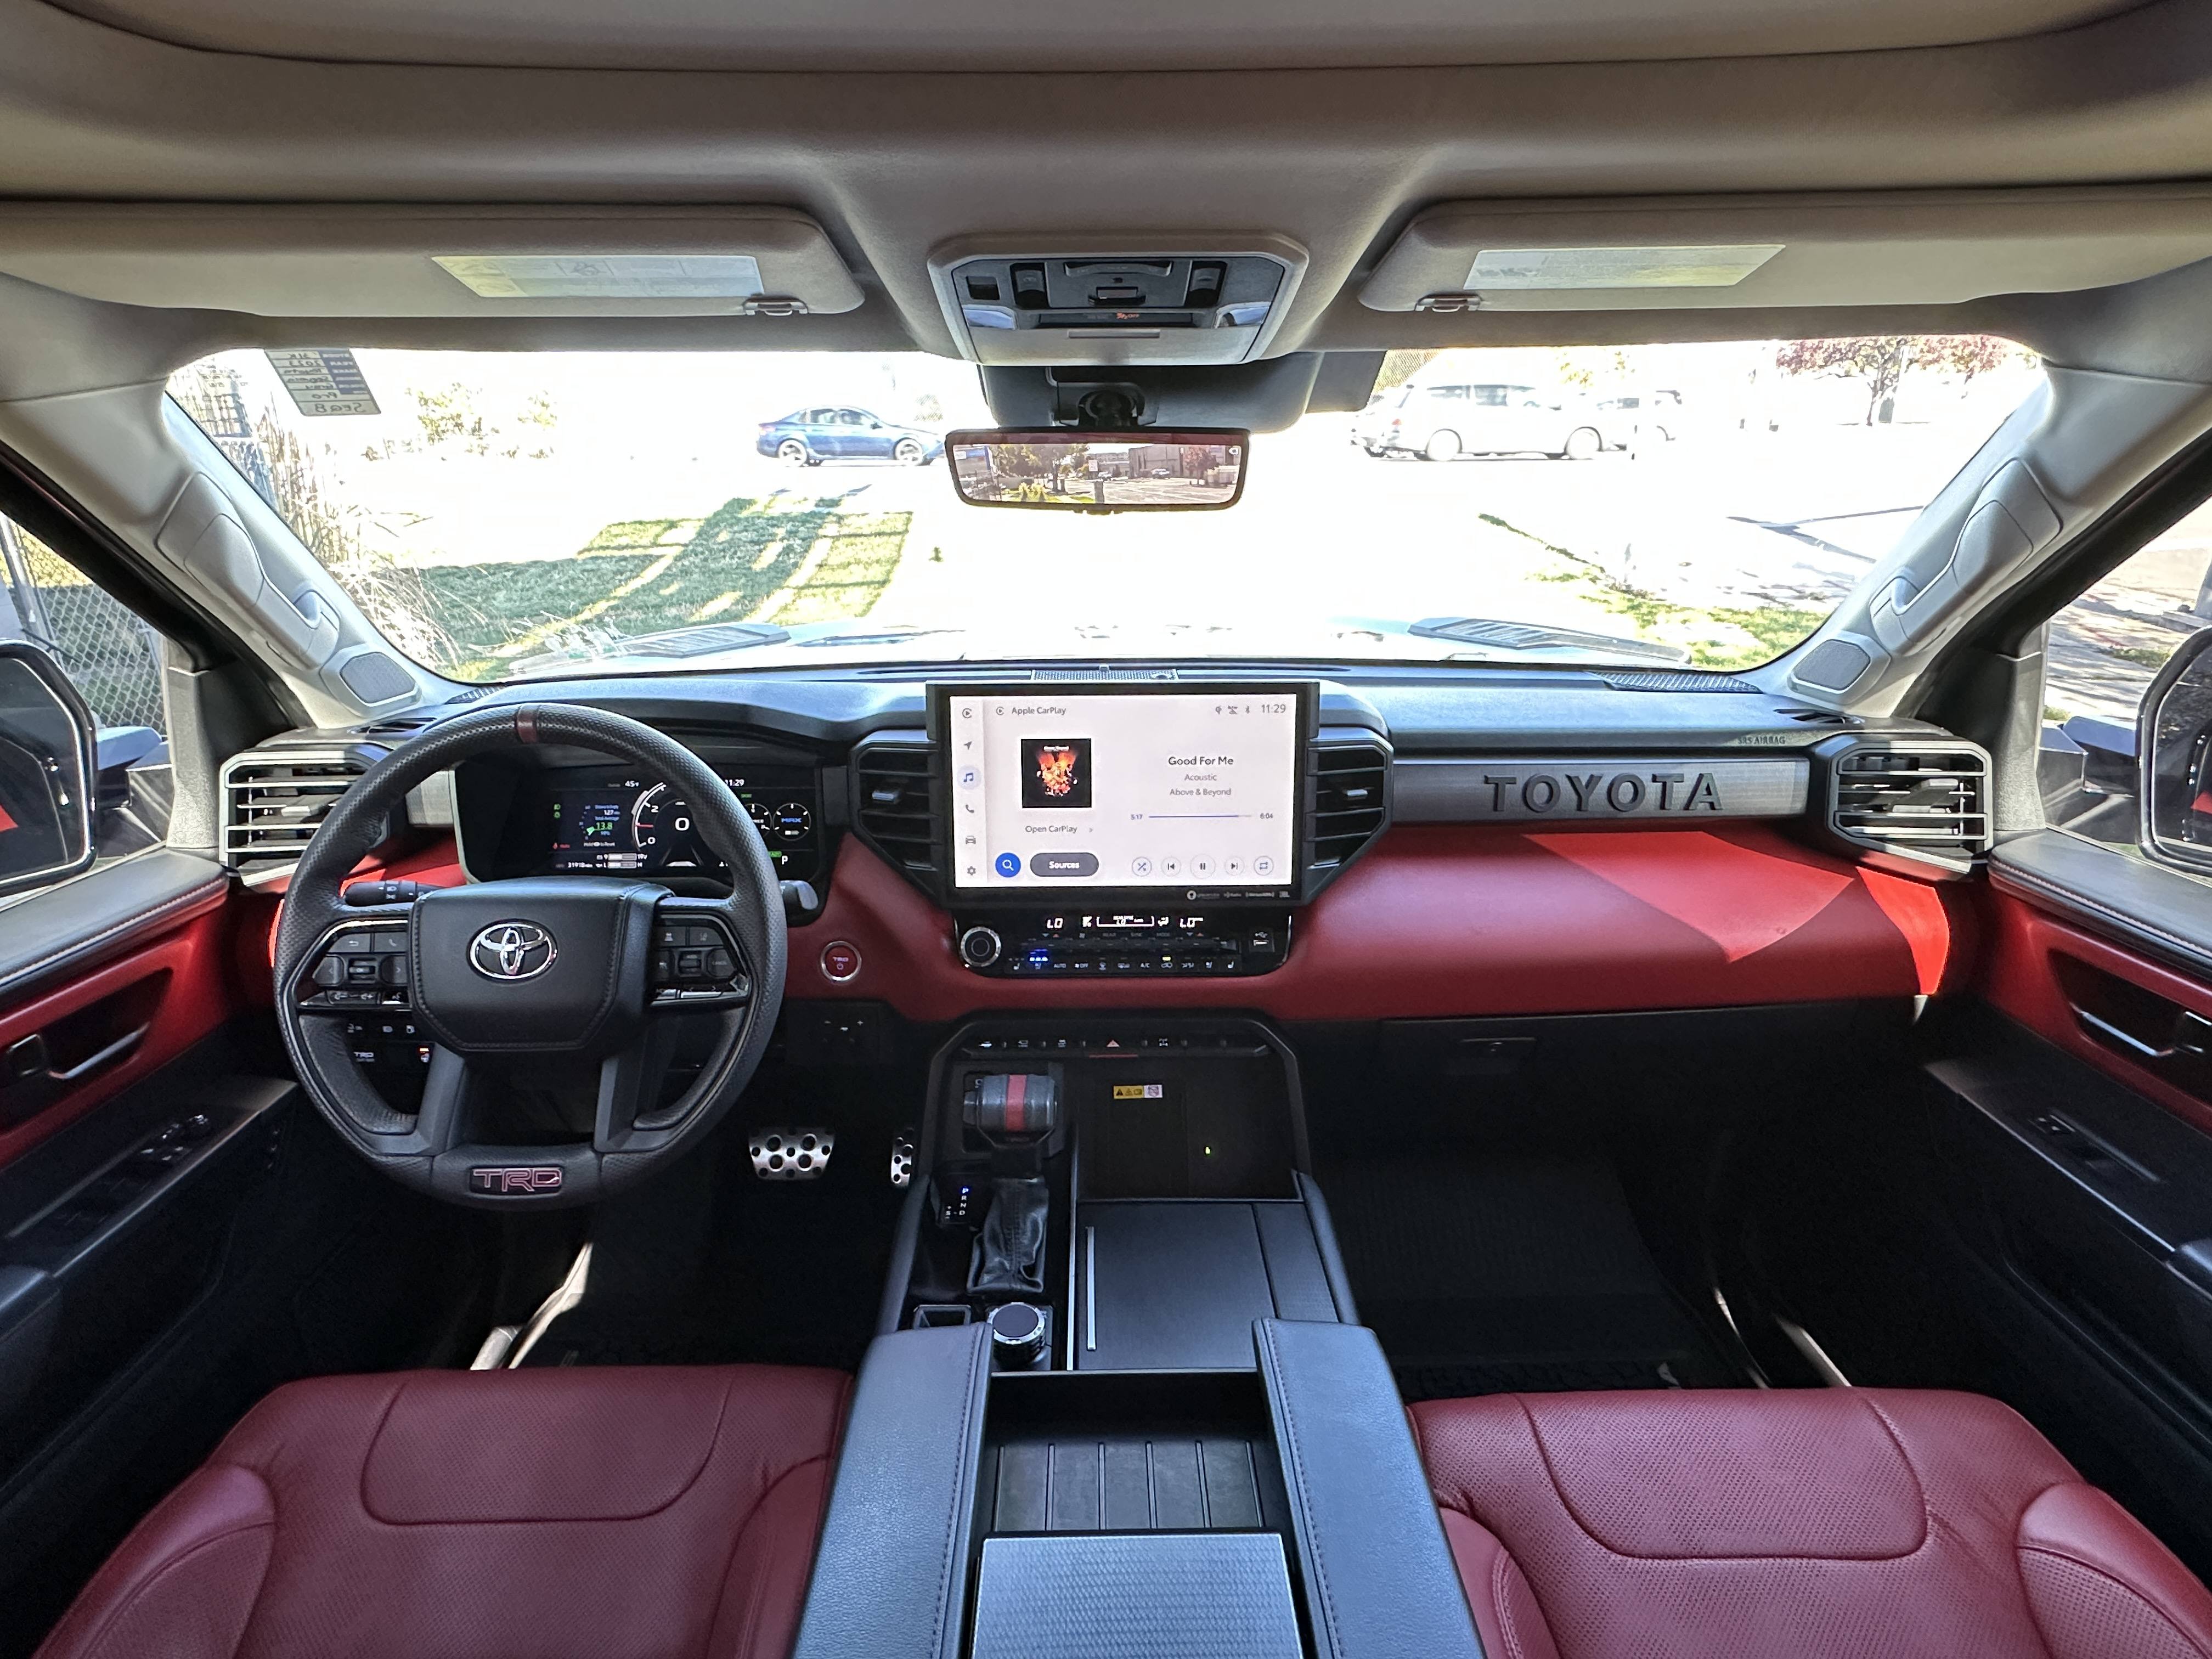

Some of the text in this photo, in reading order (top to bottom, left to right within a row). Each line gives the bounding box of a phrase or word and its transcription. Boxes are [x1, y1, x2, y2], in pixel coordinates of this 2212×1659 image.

[1012, 707, 1066, 715] Apple CarPlay
[1261, 704, 1286, 713] 11:29
[1754, 736, 1785, 744] AIRBAG
[1168, 756, 1234, 765] Good For Me
[1203, 788, 1232, 797] Beyond
[1484, 773, 1723, 812] TOYOTA
[596, 822, 613, 830] 13.8
[675, 818, 690, 831] 0
[1025, 825, 1077, 833] Open CarPlay
[781, 855, 788, 865] P
[1047, 918, 1063, 929] LO
[472, 1168, 562, 1192] TRD
